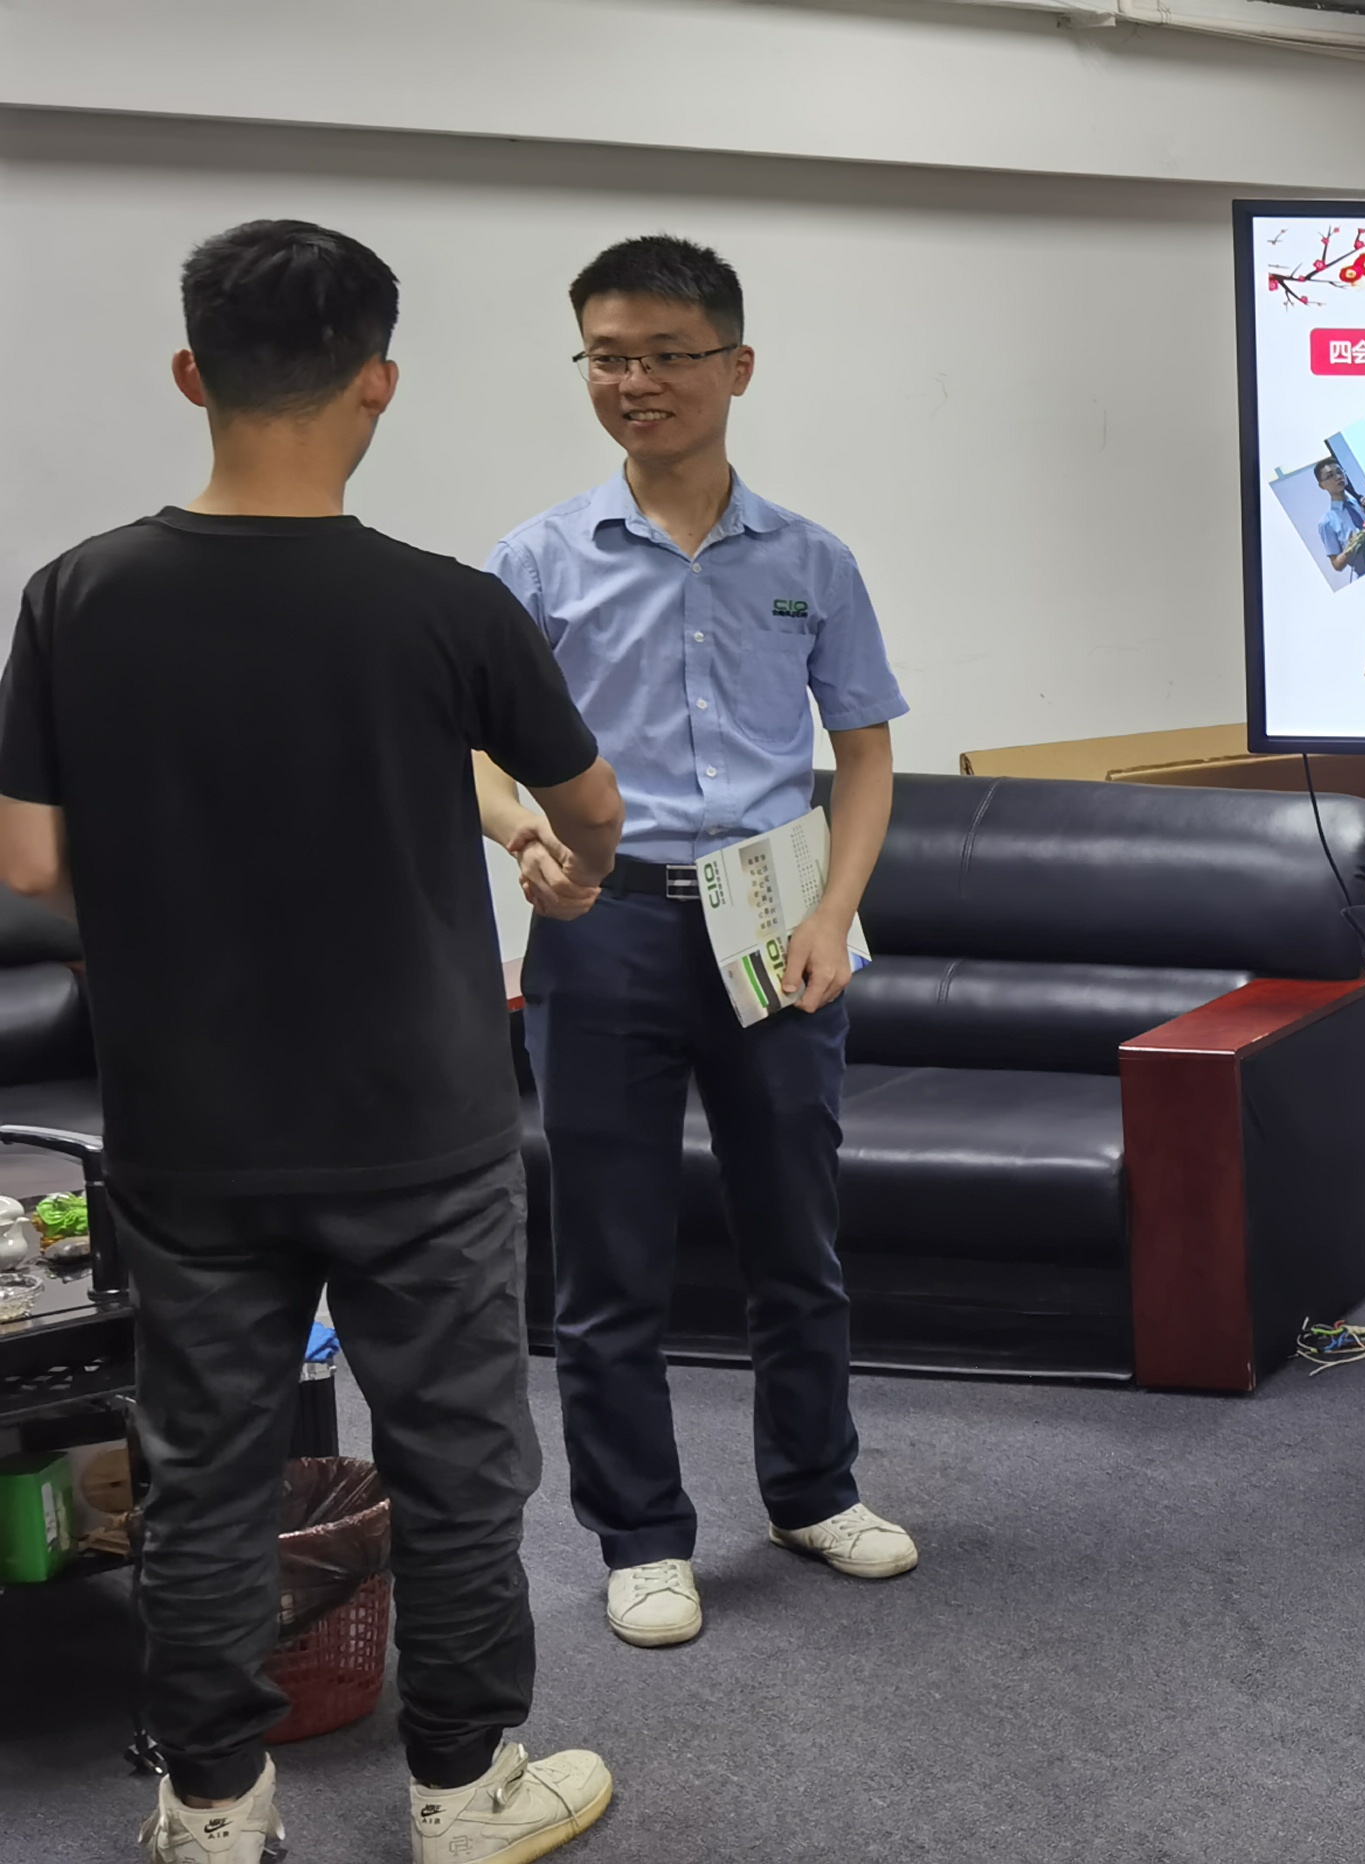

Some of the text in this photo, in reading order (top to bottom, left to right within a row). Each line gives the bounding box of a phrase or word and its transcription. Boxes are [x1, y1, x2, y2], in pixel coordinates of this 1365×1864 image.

[773, 599, 809, 612] CIO
[704, 862, 720, 909] CIO
[208, 1831, 230, 1839] AIR
